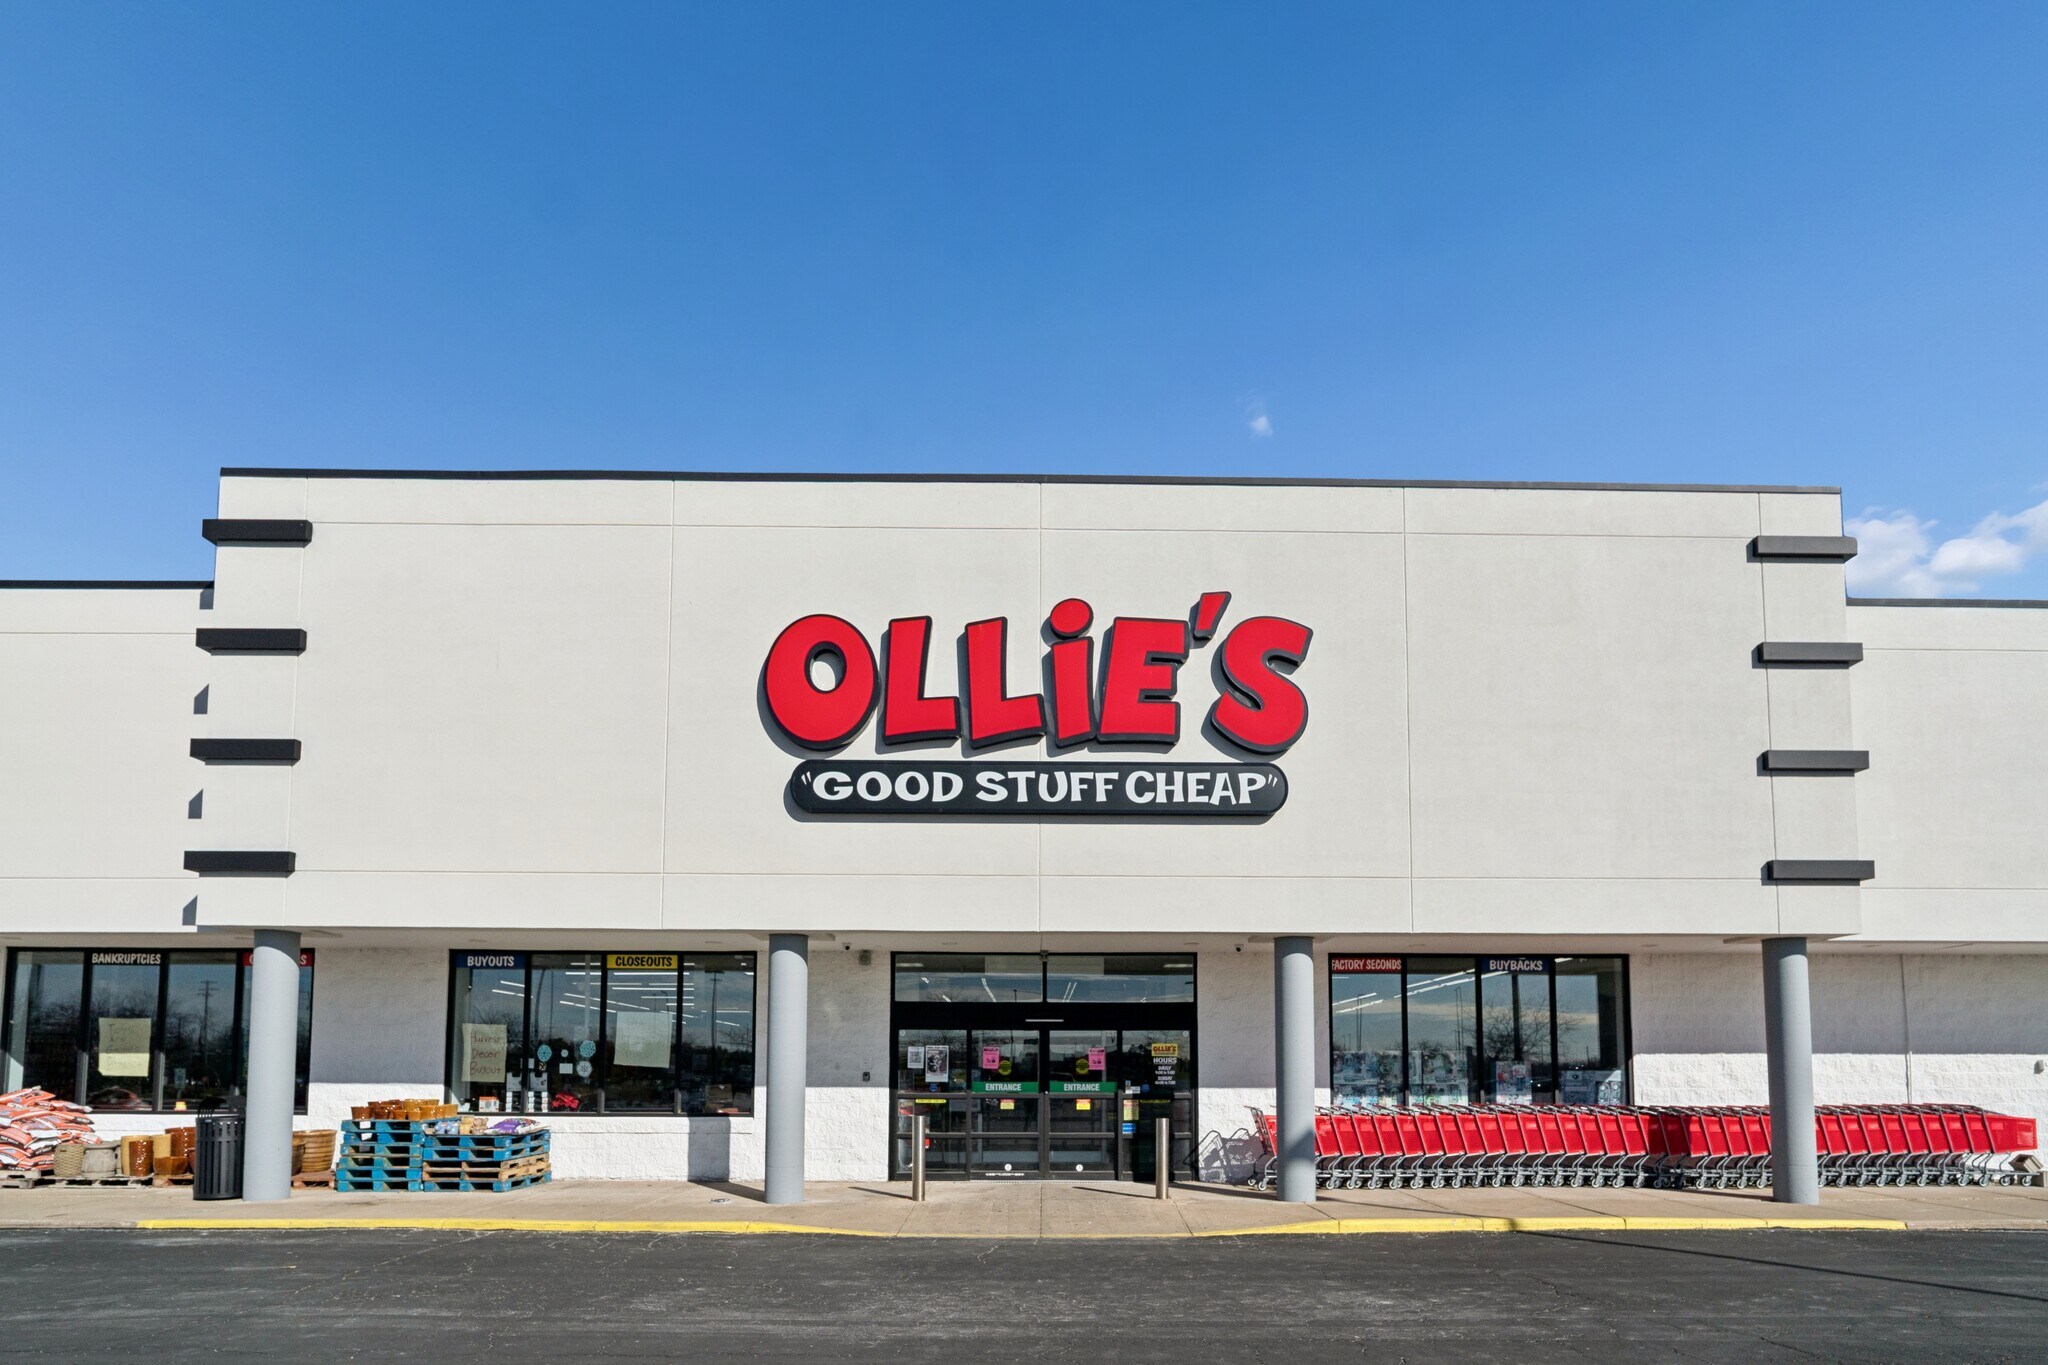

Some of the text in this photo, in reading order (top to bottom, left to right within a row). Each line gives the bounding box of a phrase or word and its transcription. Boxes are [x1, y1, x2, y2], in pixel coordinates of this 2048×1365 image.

[976, 771, 1119, 803] STUFF
[92, 953, 161, 965] BANKRUPTCIES
[467, 956, 515, 967] BUYOUTS
[615, 956, 672, 967] CLOSEOUTS
[1331, 959, 1402, 970] FACTORY SECONDS
[1489, 959, 1543, 971] BUYBACKS
[471, 1049, 500, 1060] Decor
[1153, 1057, 1177, 1065] HOURS
[470, 1061, 503, 1076] Buyout
[985, 1083, 1022, 1091] ENTRANCE
[1063, 1083, 1100, 1091] ENTRANCE
